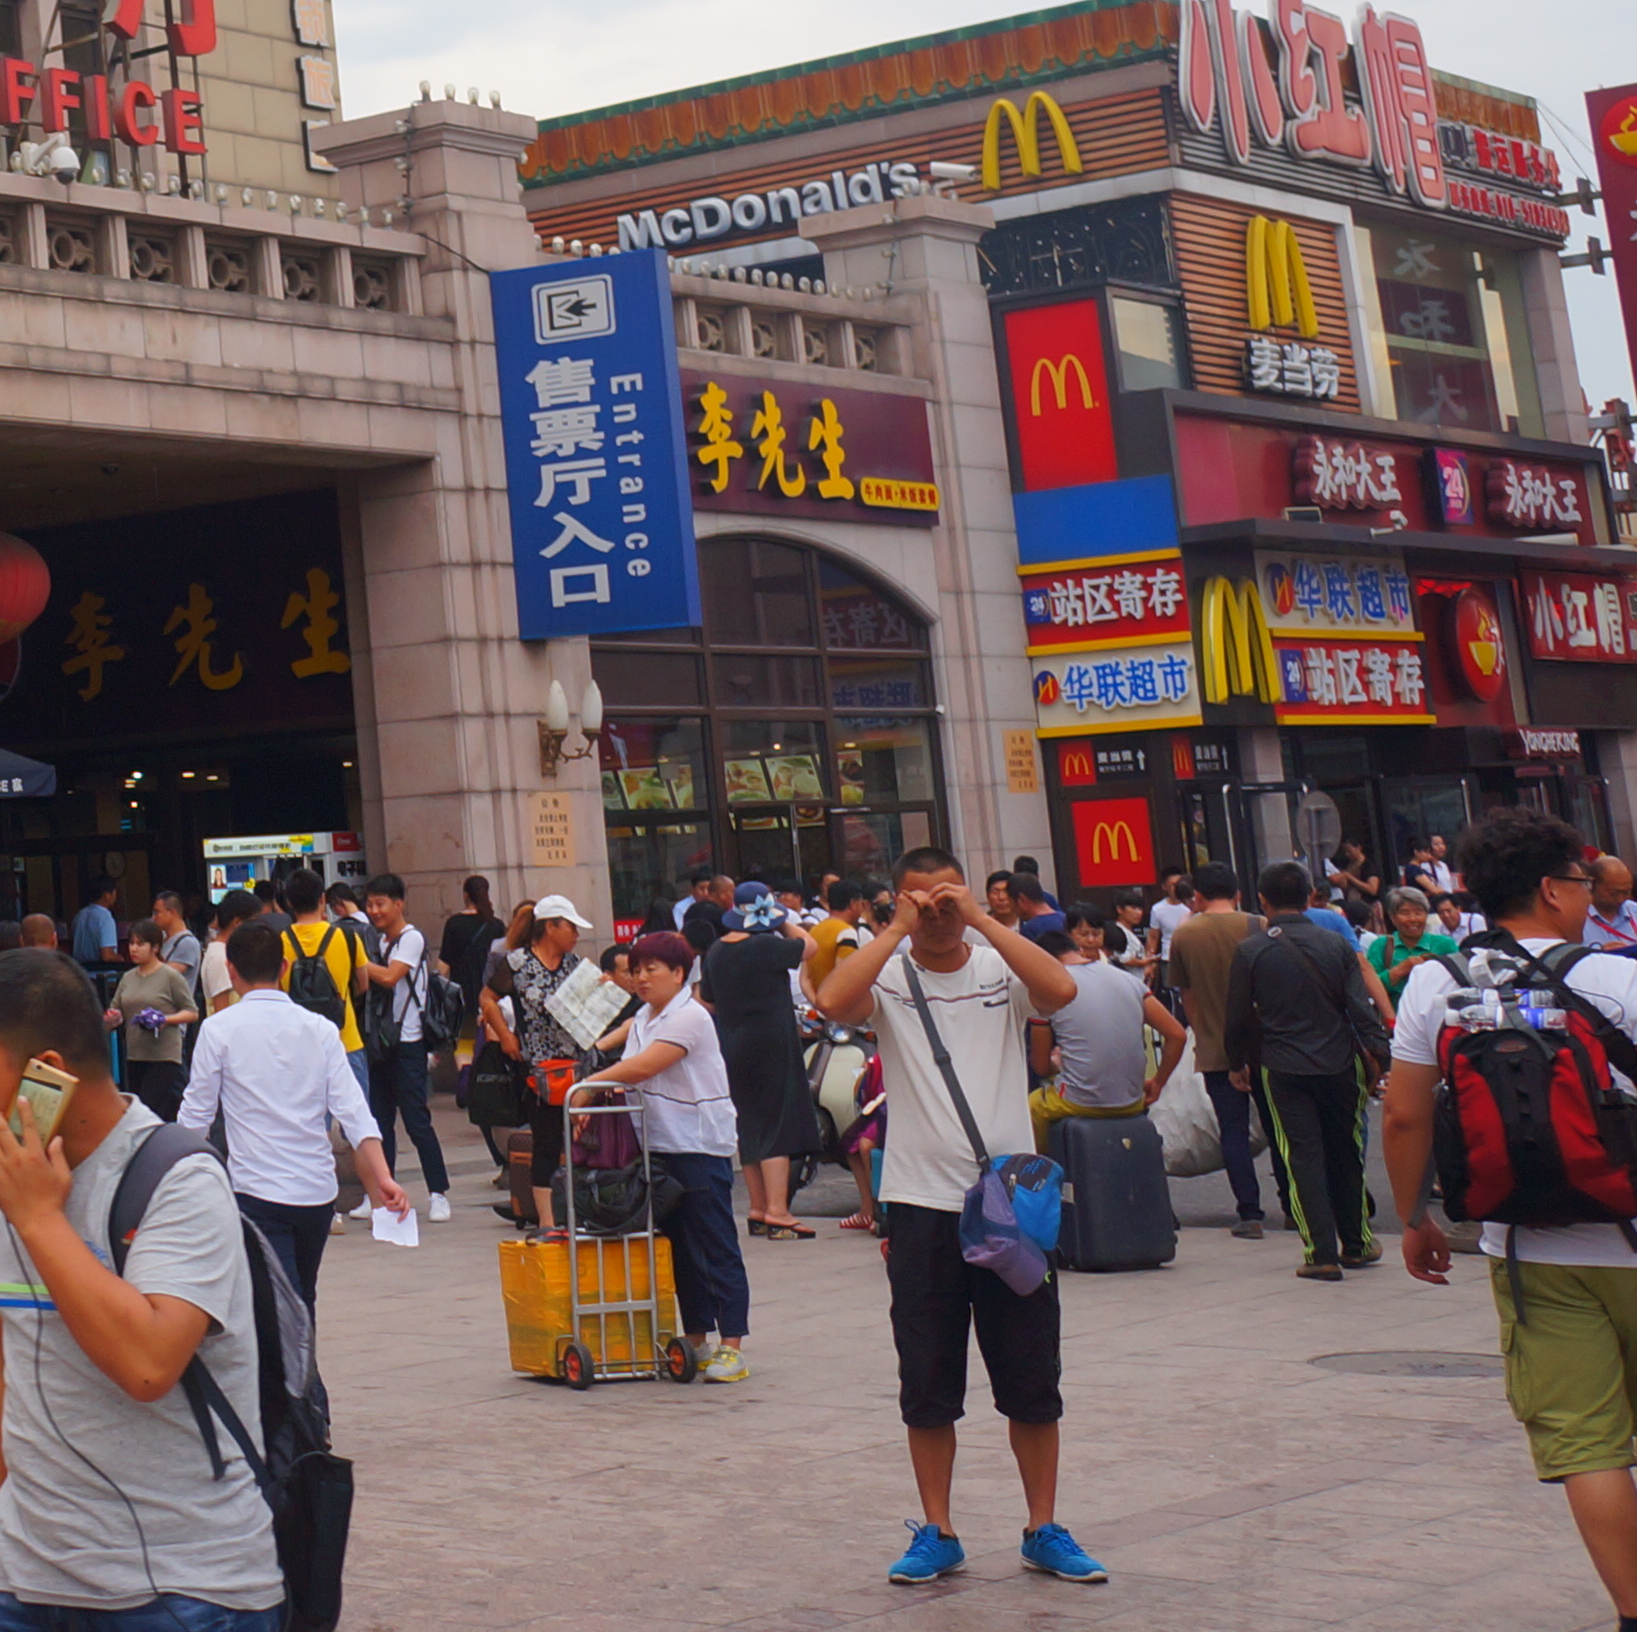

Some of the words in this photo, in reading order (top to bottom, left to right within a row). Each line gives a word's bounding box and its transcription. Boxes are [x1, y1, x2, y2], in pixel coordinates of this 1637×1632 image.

[617, 161, 920, 250] McDonald's
[1250, 337, 1340, 399] 麦当劳
[696, 380, 855, 501] 李先生
[1313, 441, 1402, 501] 永和大王
[525, 356, 615, 608] 售票厅入口
[610, 372, 651, 577] Entrance
[1505, 464, 1582, 522] 永和大王
[1050, 568, 1184, 627] 站区寄存
[1295, 559, 1410, 620] 华联超市
[1534, 576, 1625, 655] 小红帽
[61, 567, 352, 702] 李先生
[1063, 652, 1189, 710] 华联超市
[1305, 647, 1425, 706] 站区寄存
